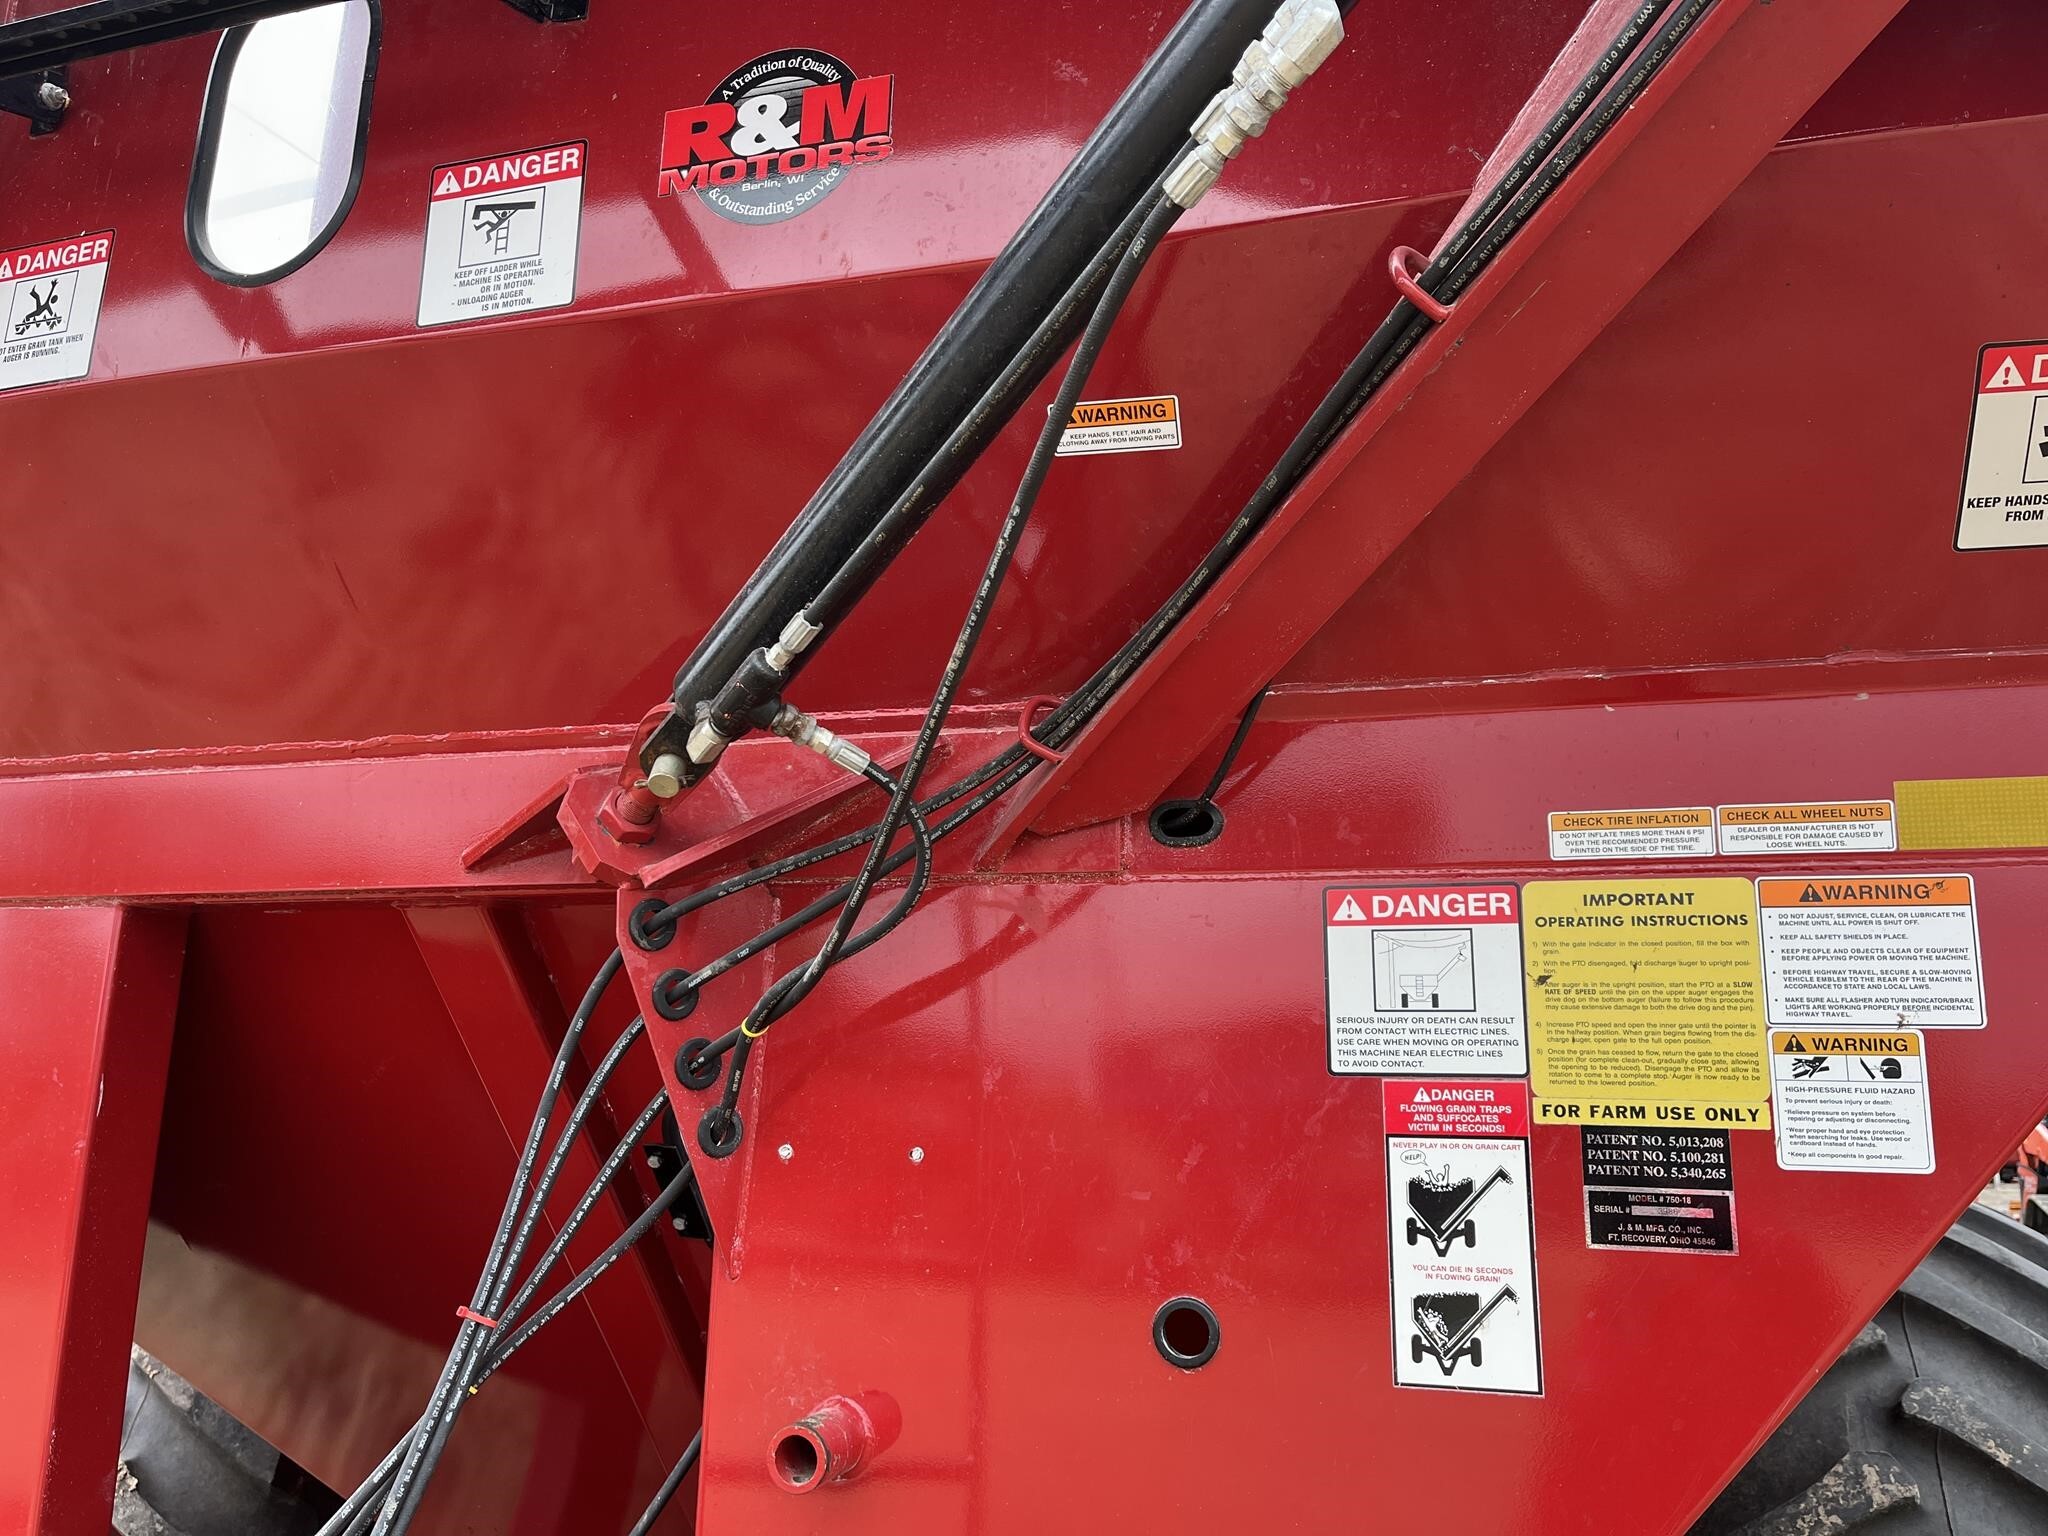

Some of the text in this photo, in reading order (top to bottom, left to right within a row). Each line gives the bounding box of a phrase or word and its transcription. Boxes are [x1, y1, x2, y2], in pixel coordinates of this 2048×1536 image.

[722, 56, 842, 100] A Tradition of Quality
[660, 74, 894, 169] R&M
[463, 148, 580, 188] DANGER
[658, 136, 893, 197] MOTORS
[742, 174, 804, 192] Berlin, WI
[708, 167, 840, 216] & Outstanding Service
[15, 239, 109, 275] DANGER
[454, 259, 542, 279] KEEP OFF LADDER WHILE
[459, 276, 492, 287] MACHINE
[504, 268, 544, 280] OPERATING
[504, 279, 535, 290] MOTION.
[457, 290, 523, 306] UNLOADING AUGER
[502, 297, 534, 308] MOTION.
[8, 344, 26, 354] ENTER
[28, 340, 46, 350] GRAIN
[49, 337, 64, 346] TANK
[66, 334, 84, 343] WHEN
[3, 354, 22, 362] AUGER
[31, 347, 60, 358] RUNNING.
[1078, 404, 1166, 423] WARNING
[1967, 497, 2001, 508] KEEP
[2006, 510, 2044, 521] FROM
[1564, 814, 1699, 827] CHECK TIRE INFLATION
[1727, 807, 1884, 820] CHECK ALL WHEEL NUTS
[1583, 892, 1694, 907] IMPORTANT
[1822, 884, 1930, 900] WARNING
[1372, 892, 1512, 918] DANGER
[1534, 914, 1748, 928] OPERATING INSTRUCTIONS
[1811, 1038, 1908, 1052] WARNING
[1431, 1089, 1494, 1101] DANGER
[1400, 1104, 1443, 1112] FLOWING
[1446, 1105, 1476, 1113] GRAIN
[1542, 1104, 1760, 1122] FOR FARM USE ONLY
[1437, 1115, 1499, 1123] SUFFOCATES
[1586, 1134, 1724, 1148] PATENT NO. 5,013,208
[1587, 1149, 1725, 1164] PATENT NO. 5,100,281
[1588, 1165, 1726, 1180] PATENT NO. 5,340,265
[1622, 1234, 1668, 1244] RECOVERY,
